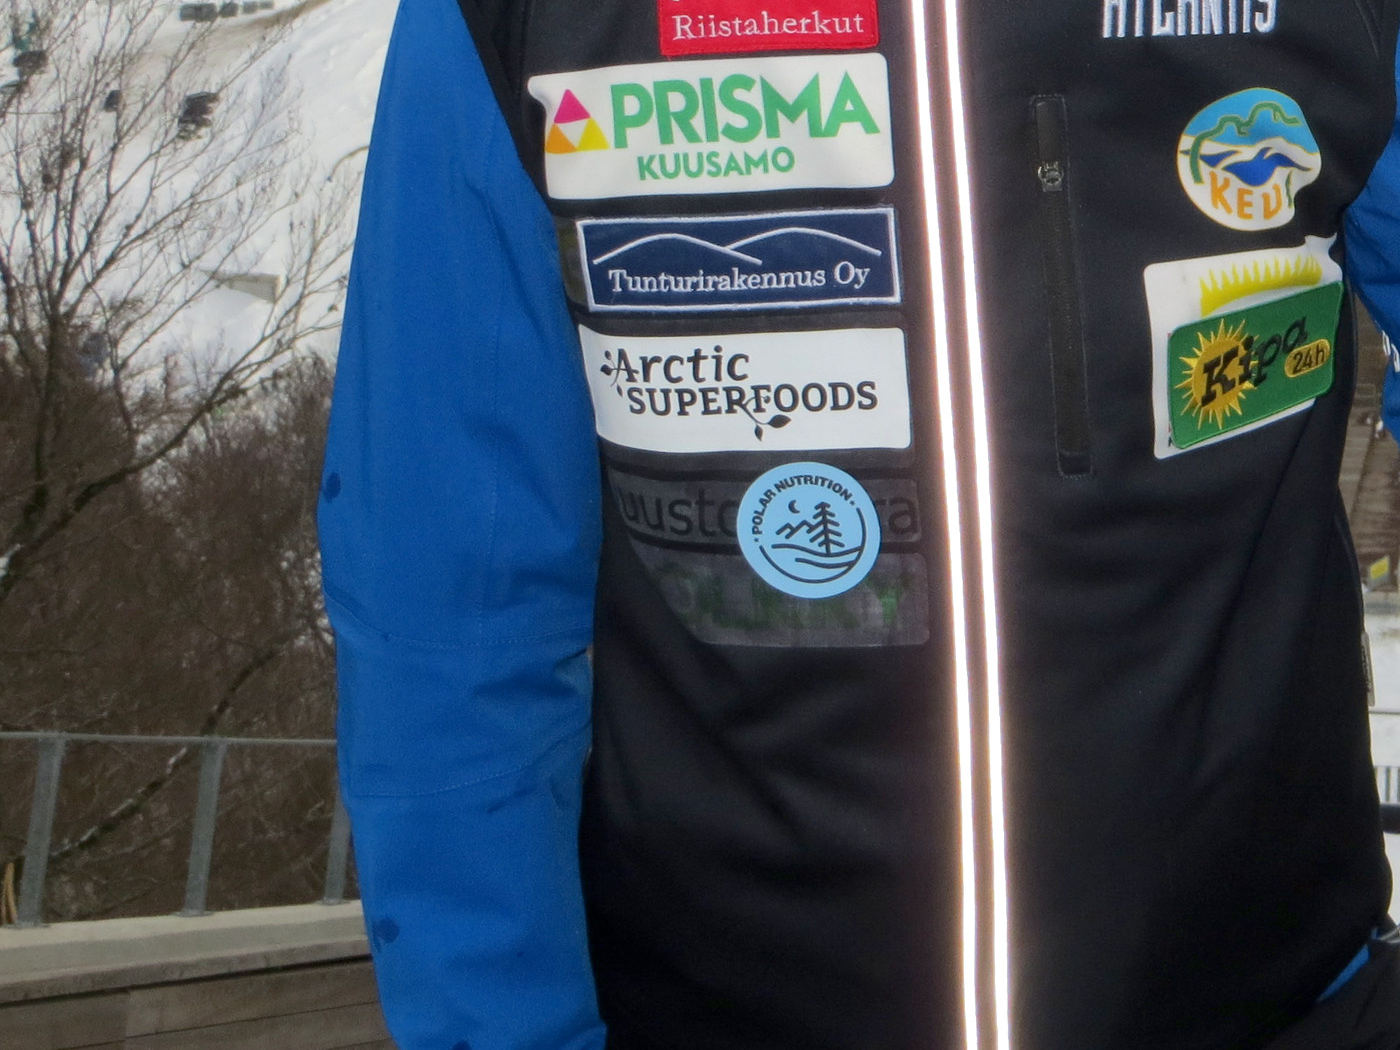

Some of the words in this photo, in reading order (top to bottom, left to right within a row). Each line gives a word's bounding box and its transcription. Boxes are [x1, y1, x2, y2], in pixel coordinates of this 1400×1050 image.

[671, 10, 865, 41] Riistaherkut
[609, 71, 881, 150] PRISMA
[637, 146, 796, 181] KUUSAMO
[608, 266, 827, 294] Tunturirakennus
[833, 260, 871, 290] Oy
[612, 345, 750, 384] Arctic
[1292, 348, 1326, 376] 24h
[628, 381, 879, 417] SUPERFOODS
[751, 489, 777, 535] POLAR
[773, 474, 853, 502] NUTRITION
